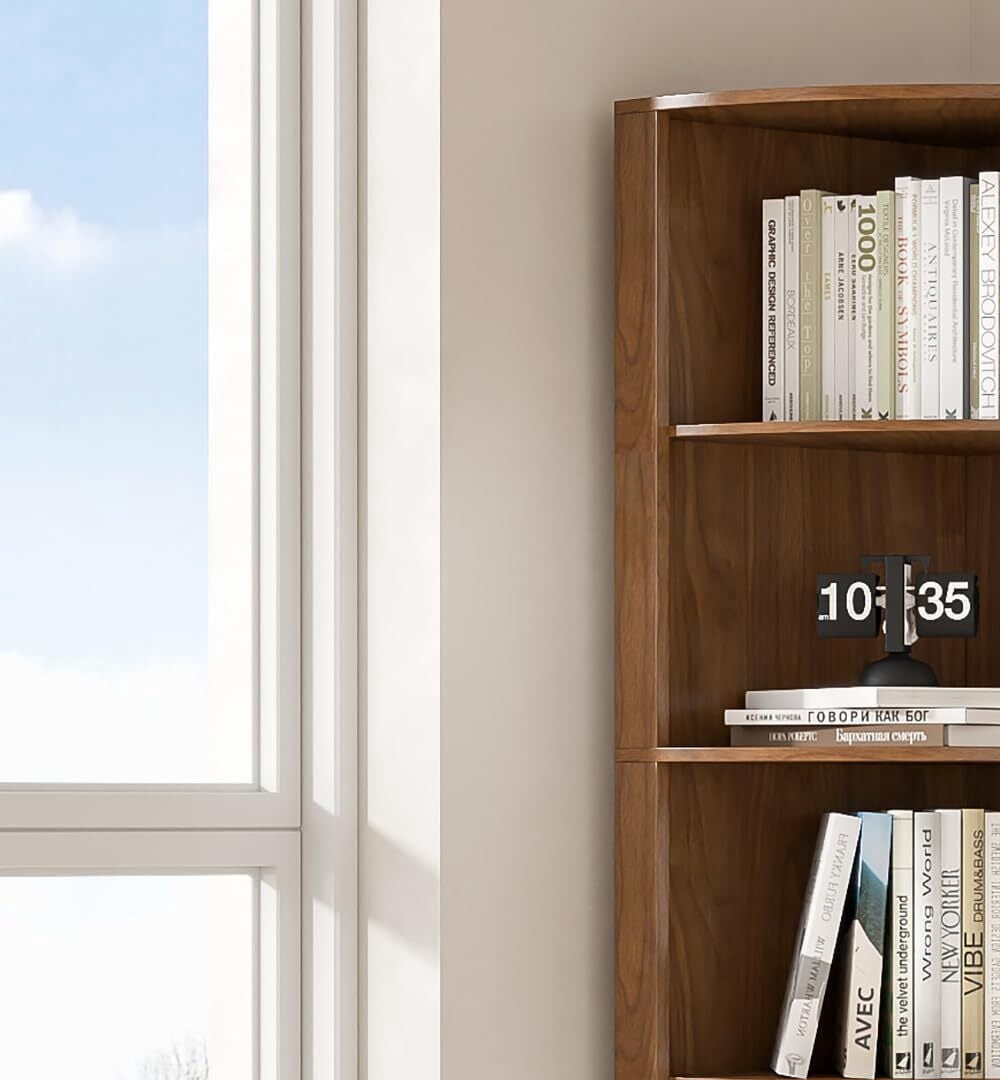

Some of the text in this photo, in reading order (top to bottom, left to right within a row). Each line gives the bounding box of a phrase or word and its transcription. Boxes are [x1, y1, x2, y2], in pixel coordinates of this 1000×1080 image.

[858, 203, 876, 272] 1000
[897, 236, 909, 287] BOOK
[767, 219, 777, 386] GRAPHIC DESIGN REFERENCED
[786, 289, 796, 351] BORDEAUX
[837, 251, 845, 321] ARNE JACOBSEN
[926, 242, 937, 363] ANTIQUAIRES
[981, 178, 996, 409] ALEXEY BRODOVITCH
[897, 305, 909, 394] SYMBOLS
[820, 581, 872, 621] 10
[918, 581, 971, 621] 35
[808, 711, 870, 723] ГОВОРИ
[875, 710, 900, 722] КАК
[905, 710, 930, 722] БОГ
[835, 728, 890, 744] Бархатная
[891, 731, 927, 745] смерть
[922, 829, 934, 982] Wrong World
[941, 869, 960, 984] NEW YORKER
[964, 830, 984, 996] VIBE DRUM&BASS
[897, 895, 910, 1037] the velvet underground
[855, 986, 874, 1051] AVEC
